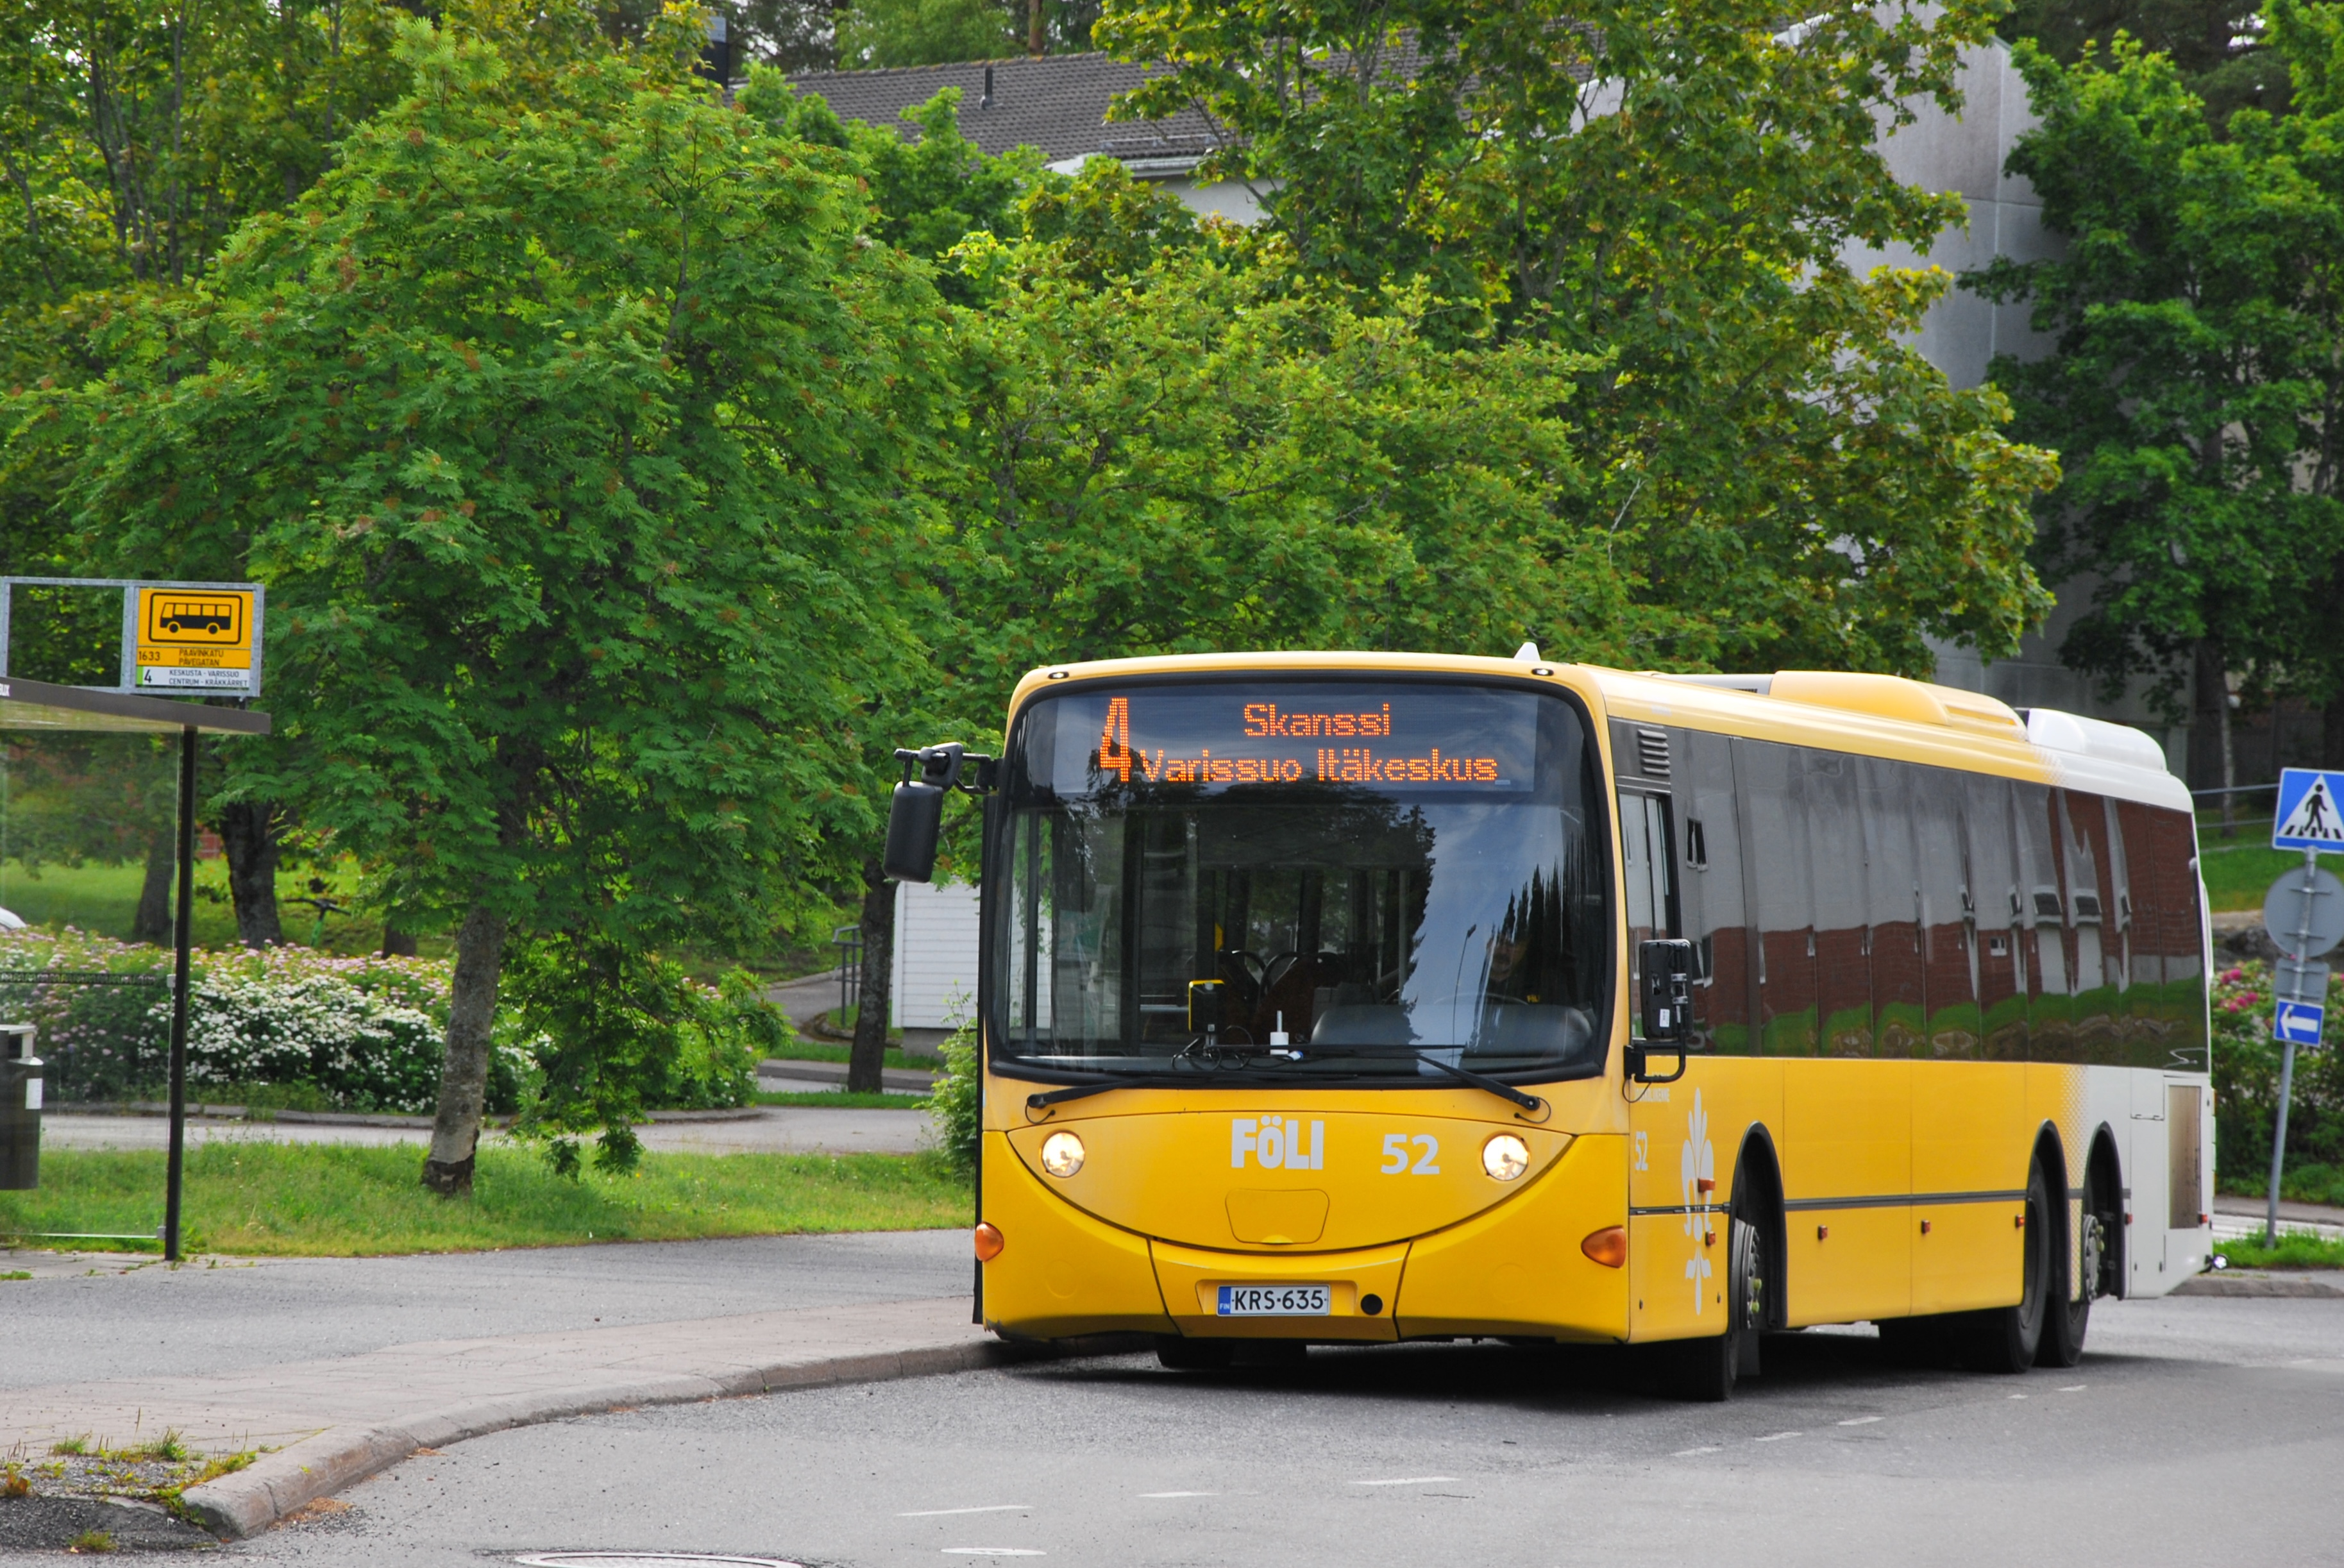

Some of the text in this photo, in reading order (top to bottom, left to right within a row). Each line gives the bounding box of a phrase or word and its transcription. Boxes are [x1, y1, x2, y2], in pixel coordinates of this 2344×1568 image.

[139, 651, 160, 661] 1633
[179, 648, 224, 658] PAAVINKATU
[144, 669, 152, 684] 4
[205, 677, 248, 687] KRÅKKÄRRET
[1244, 703, 1390, 736] Skanssi
[1100, 697, 1131, 782] 4
[1140, 748, 1497, 782] Varissuo Itäkeskus
[1231, 1115, 1324, 1170] FÖLI
[1381, 1134, 1440, 1175] 52
[1635, 1131, 1649, 1170] 52
[1235, 1290, 1324, 1310] KRS-635
